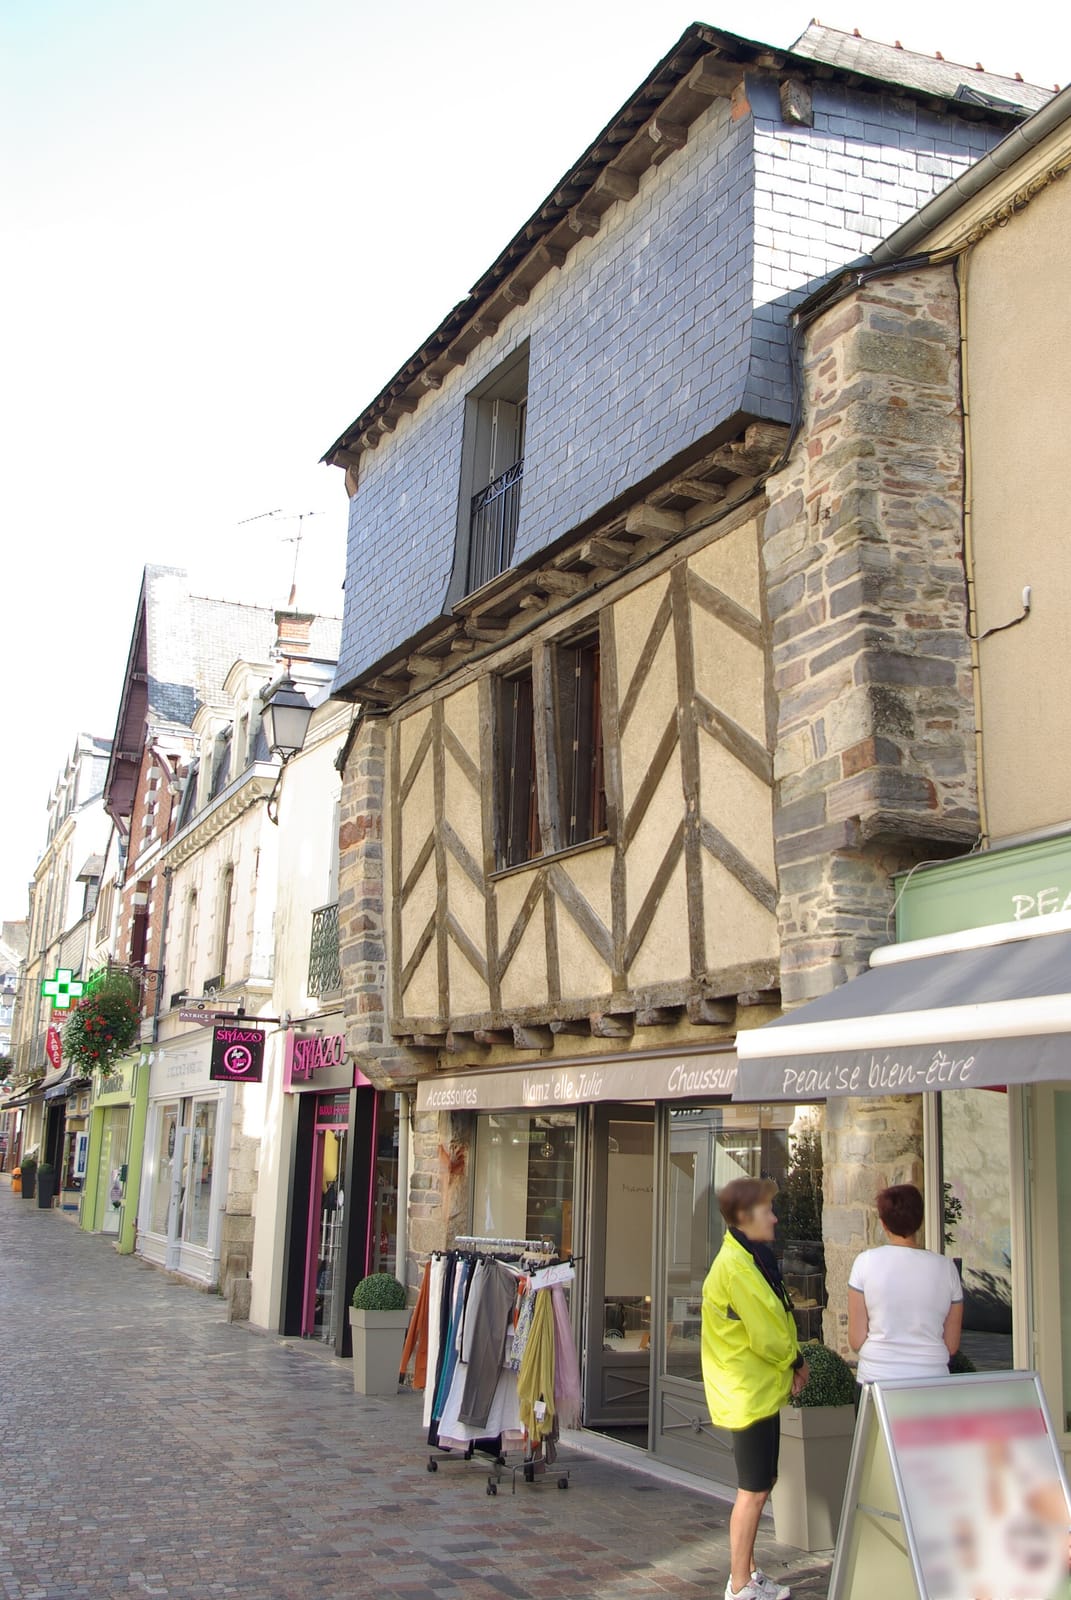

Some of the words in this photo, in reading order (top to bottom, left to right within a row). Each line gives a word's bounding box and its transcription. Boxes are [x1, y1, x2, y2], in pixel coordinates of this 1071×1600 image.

[50, 1032, 59, 1063] TABAC
[426, 1086, 477, 1107] Accessoires
[576, 1071, 603, 1097] Julia
[783, 1065, 860, 1094] Peau'se
[868, 1050, 976, 1088] bien-être
